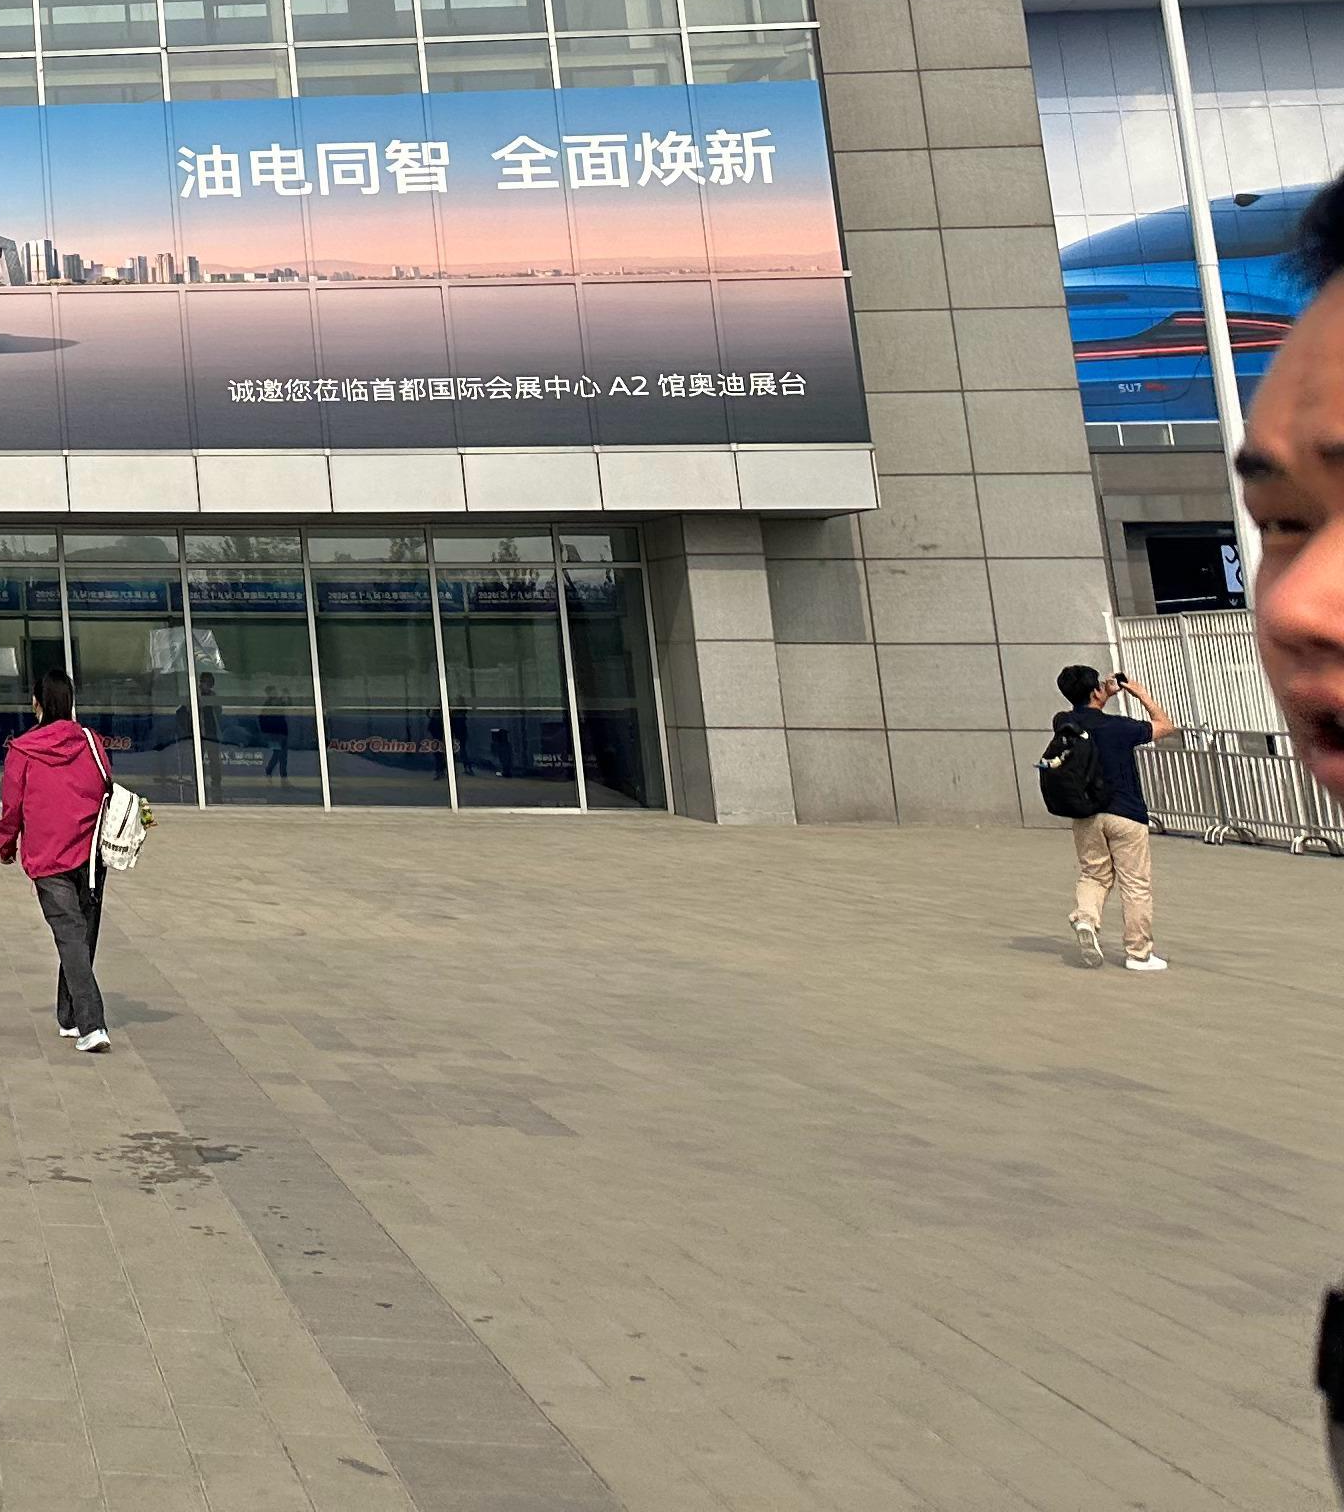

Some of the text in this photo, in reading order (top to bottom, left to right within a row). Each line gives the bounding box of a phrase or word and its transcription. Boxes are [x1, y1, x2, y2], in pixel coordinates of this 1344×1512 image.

[177, 129, 776, 199] 油电同智 全面焕新
[227, 372, 807, 402] 诚邀您莅临首都国际会展中心 A2 馆奥迪展台
